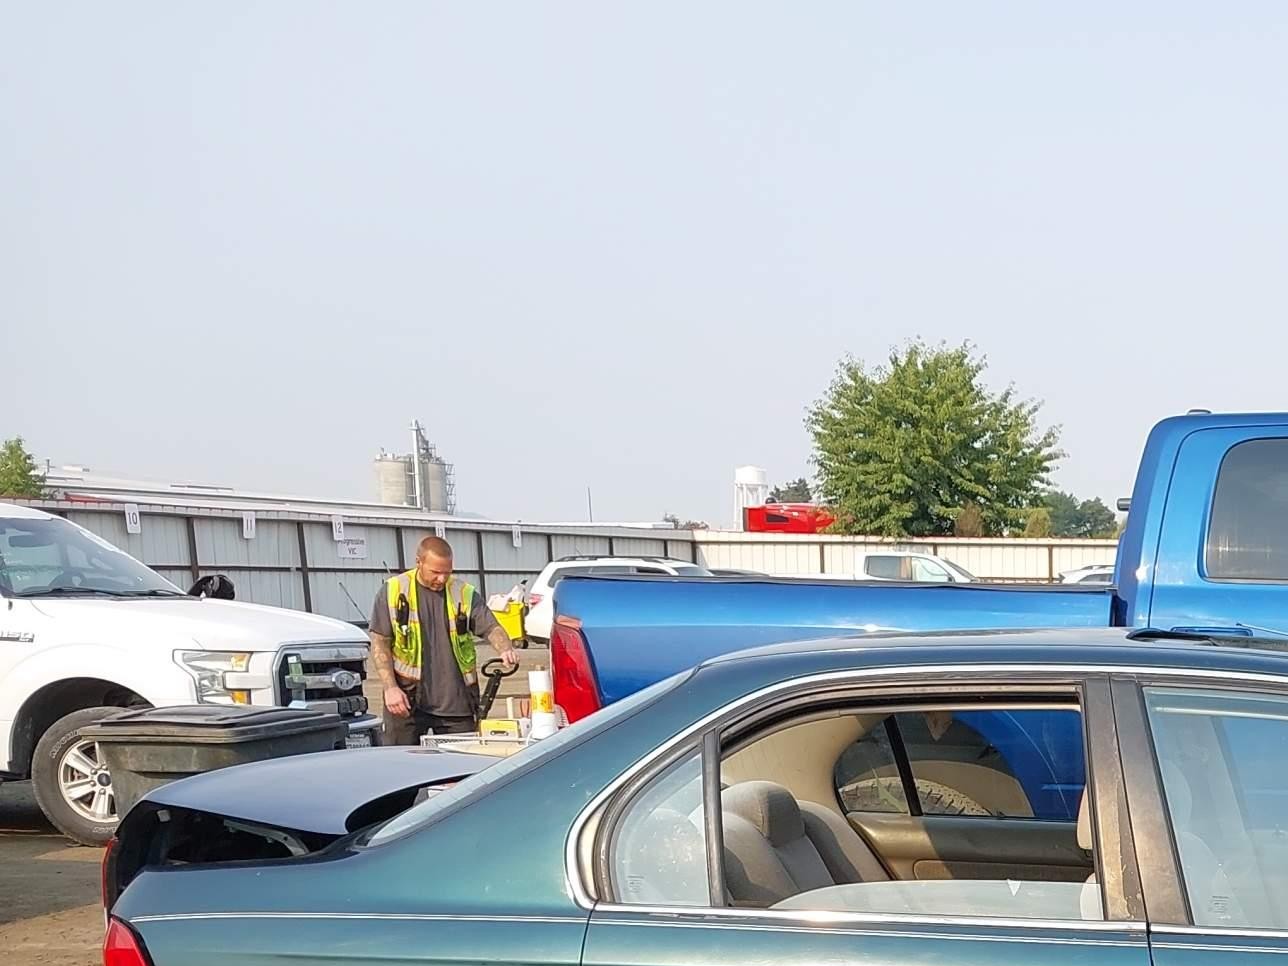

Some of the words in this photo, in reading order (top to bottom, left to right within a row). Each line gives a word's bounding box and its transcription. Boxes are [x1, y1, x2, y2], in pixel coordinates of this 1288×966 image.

[127, 511, 138, 525] 10
[245, 518, 253, 532] 11
[335, 521, 343, 534] 12
